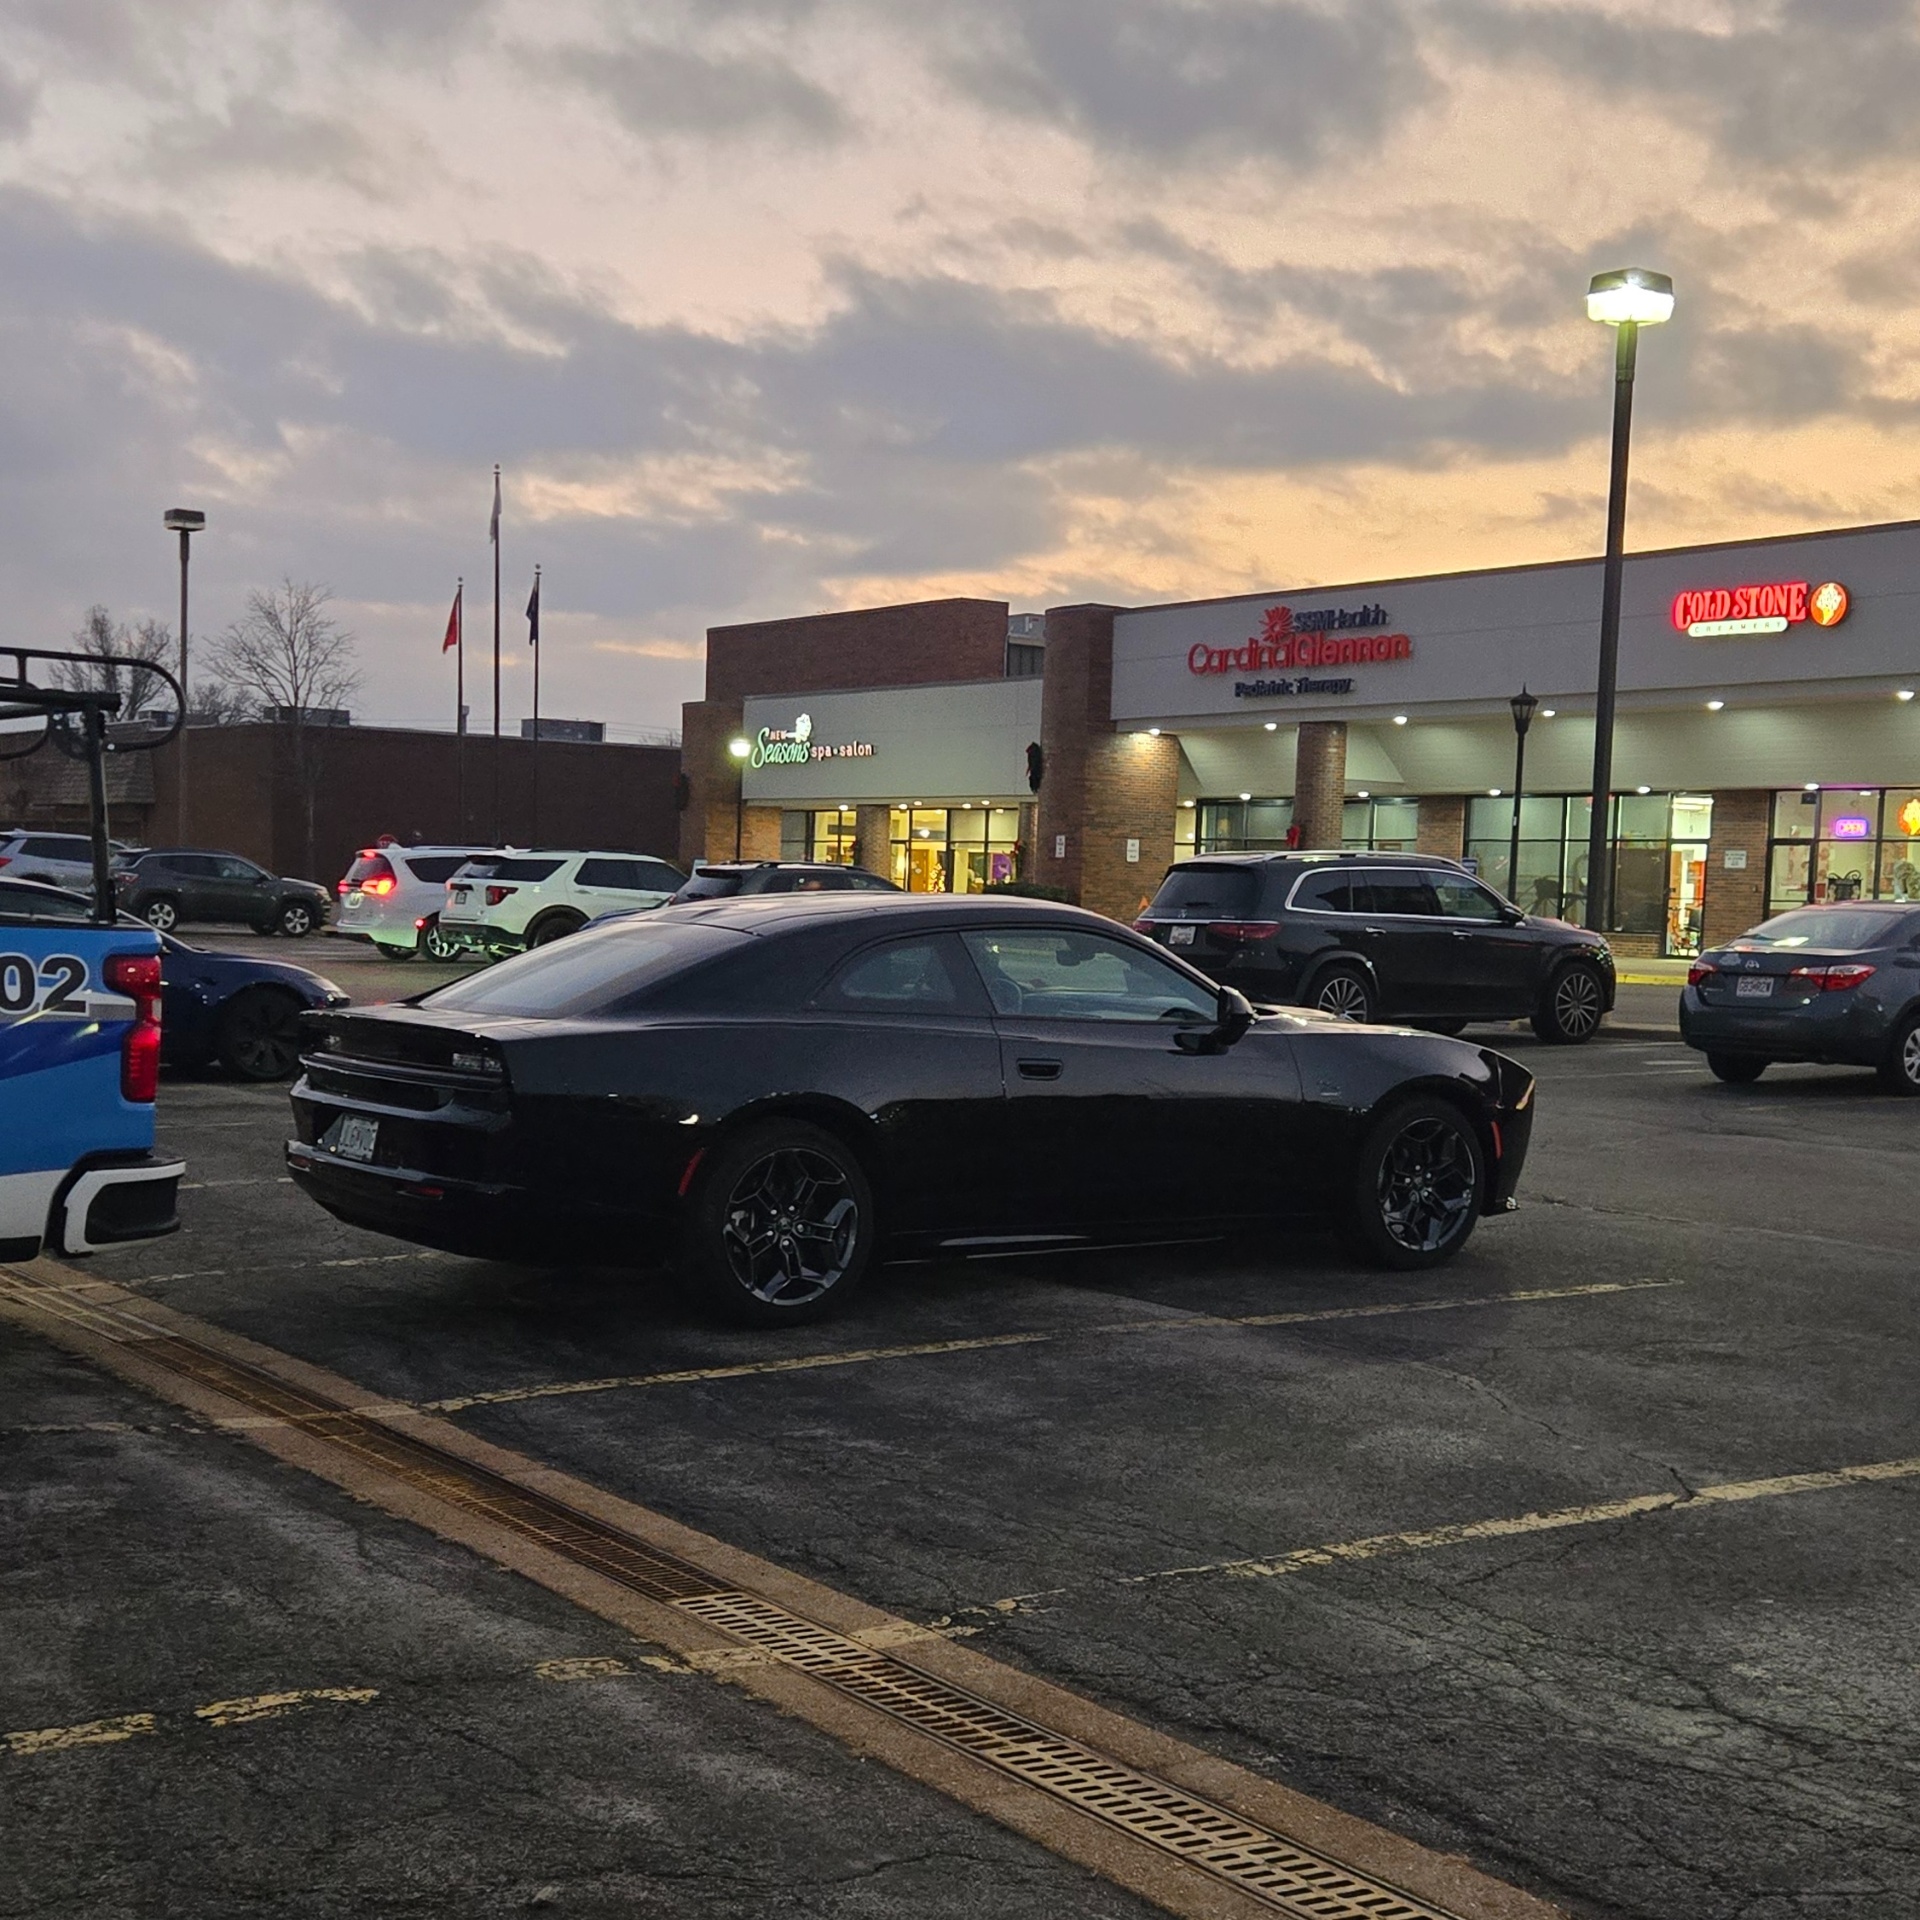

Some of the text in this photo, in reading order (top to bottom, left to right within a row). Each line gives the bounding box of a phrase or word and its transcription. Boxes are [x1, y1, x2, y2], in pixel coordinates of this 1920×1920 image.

[1674, 583, 1808, 630] COLD STONE
[1694, 620, 1782, 634] CREAMERY
[1235, 677, 1352, 698] Pediatric Therapy
[751, 726, 873, 769] Seasons spa salon
[769, 730, 788, 741] NEW
[0, 953, 89, 1016] 02
